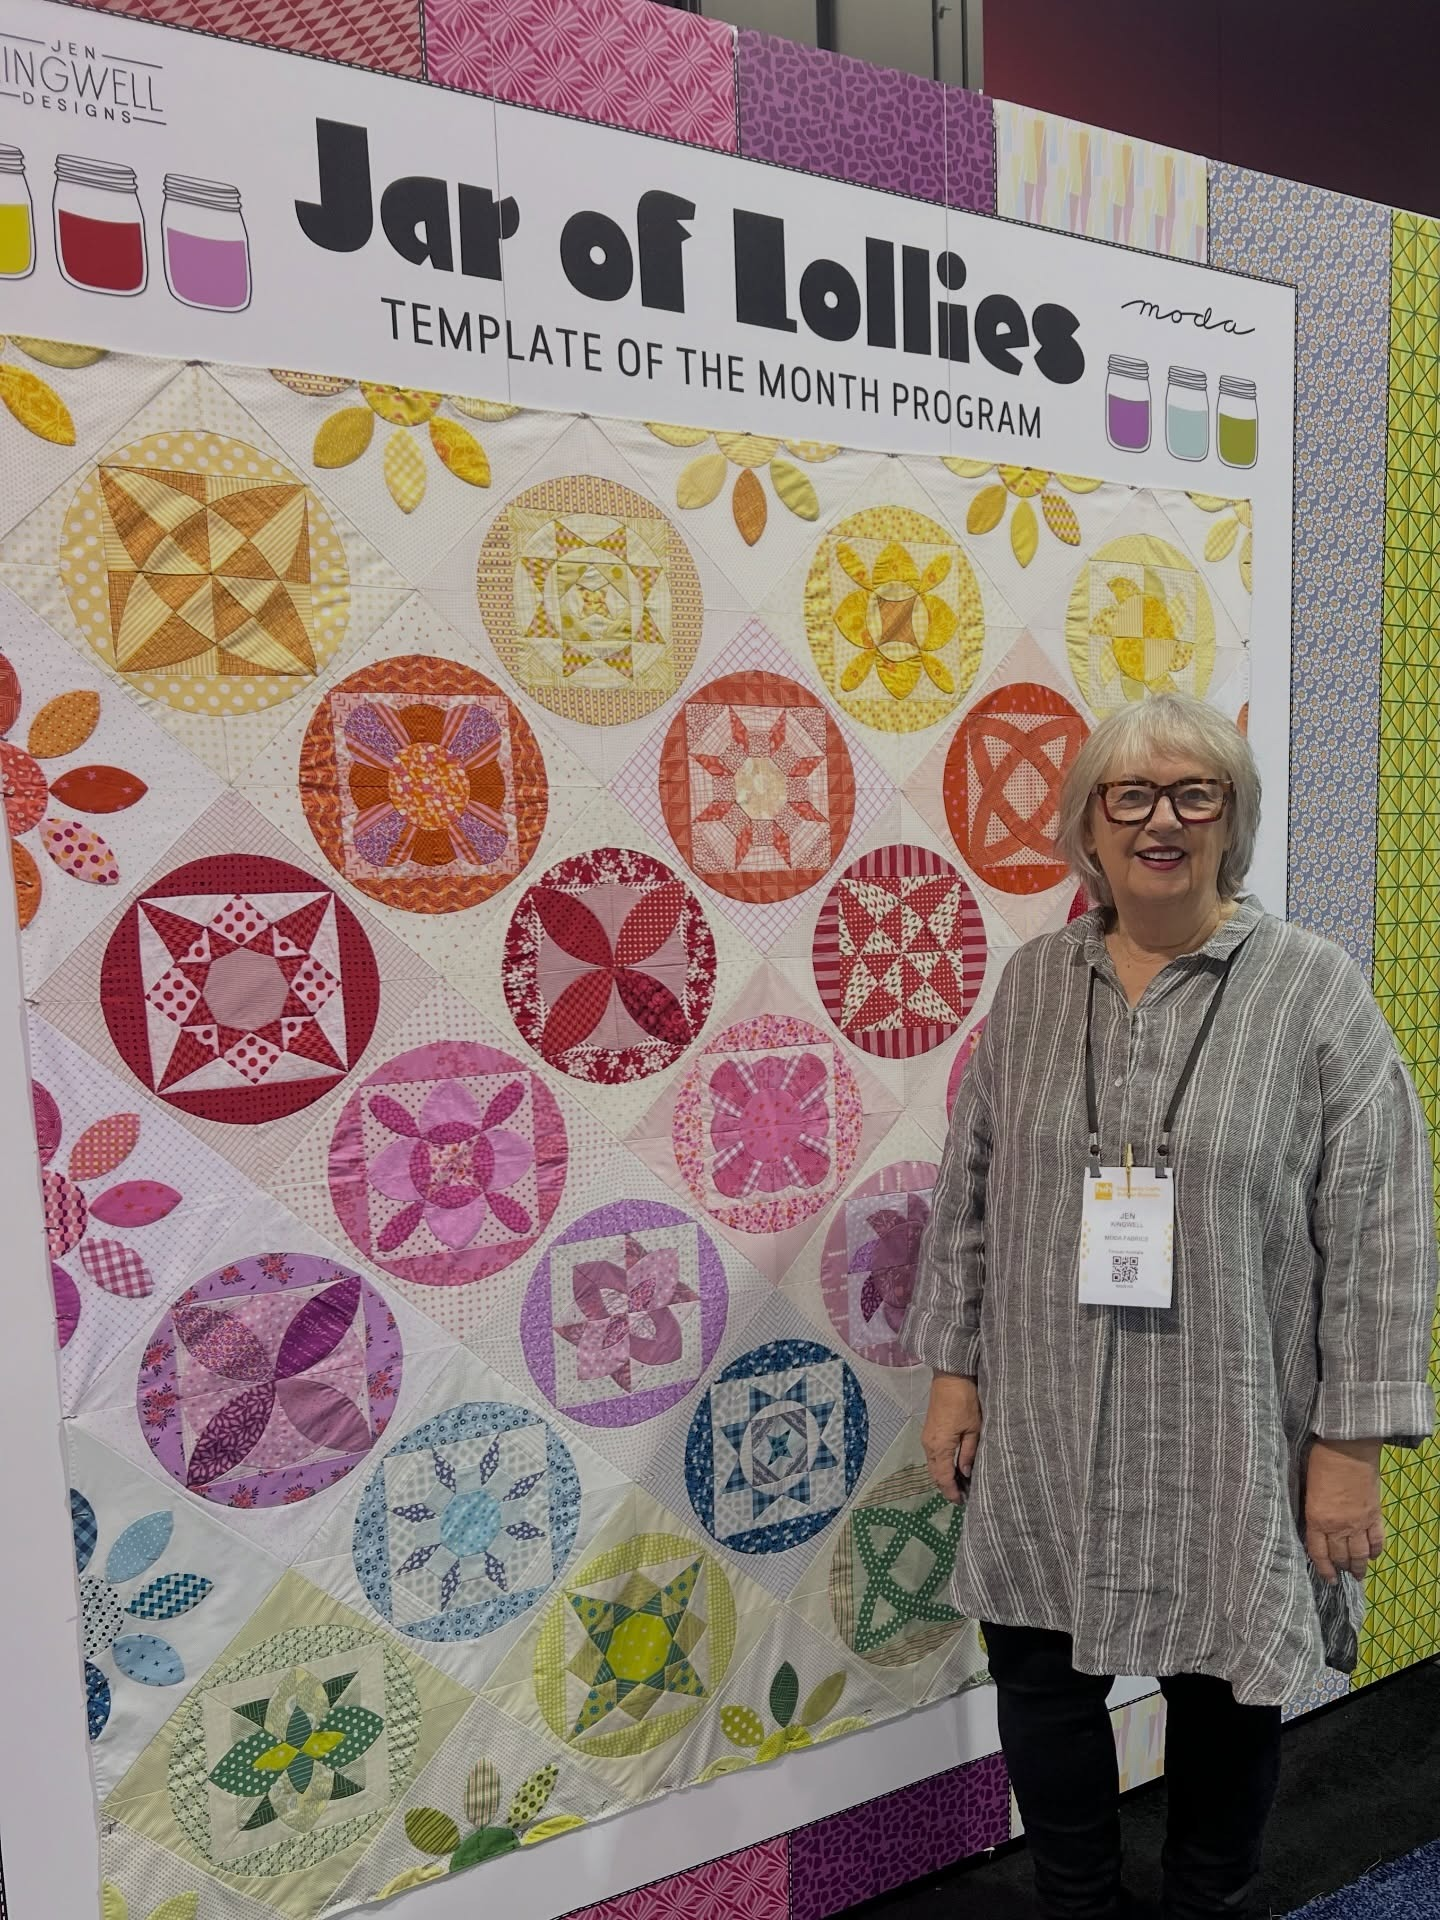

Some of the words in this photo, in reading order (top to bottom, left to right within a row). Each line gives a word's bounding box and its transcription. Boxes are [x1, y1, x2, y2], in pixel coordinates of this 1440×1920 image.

[50, 39, 96, 60] JEN
[3, 45, 164, 113] INGWELL
[22, 91, 132, 124] DESIGNS
[294, 117, 520, 282] Jar
[559, 189, 697, 314] of
[733, 208, 1085, 385] Lollies
[1121, 299, 1257, 335] moda
[380, 297, 604, 372] TEMPLATE
[617, 338, 663, 383] OF
[676, 346, 745, 393] THE
[759, 360, 879, 414] MONTH
[893, 382, 1042, 439] PROGRAM
[1120, 1212, 1136, 1220] JEN
